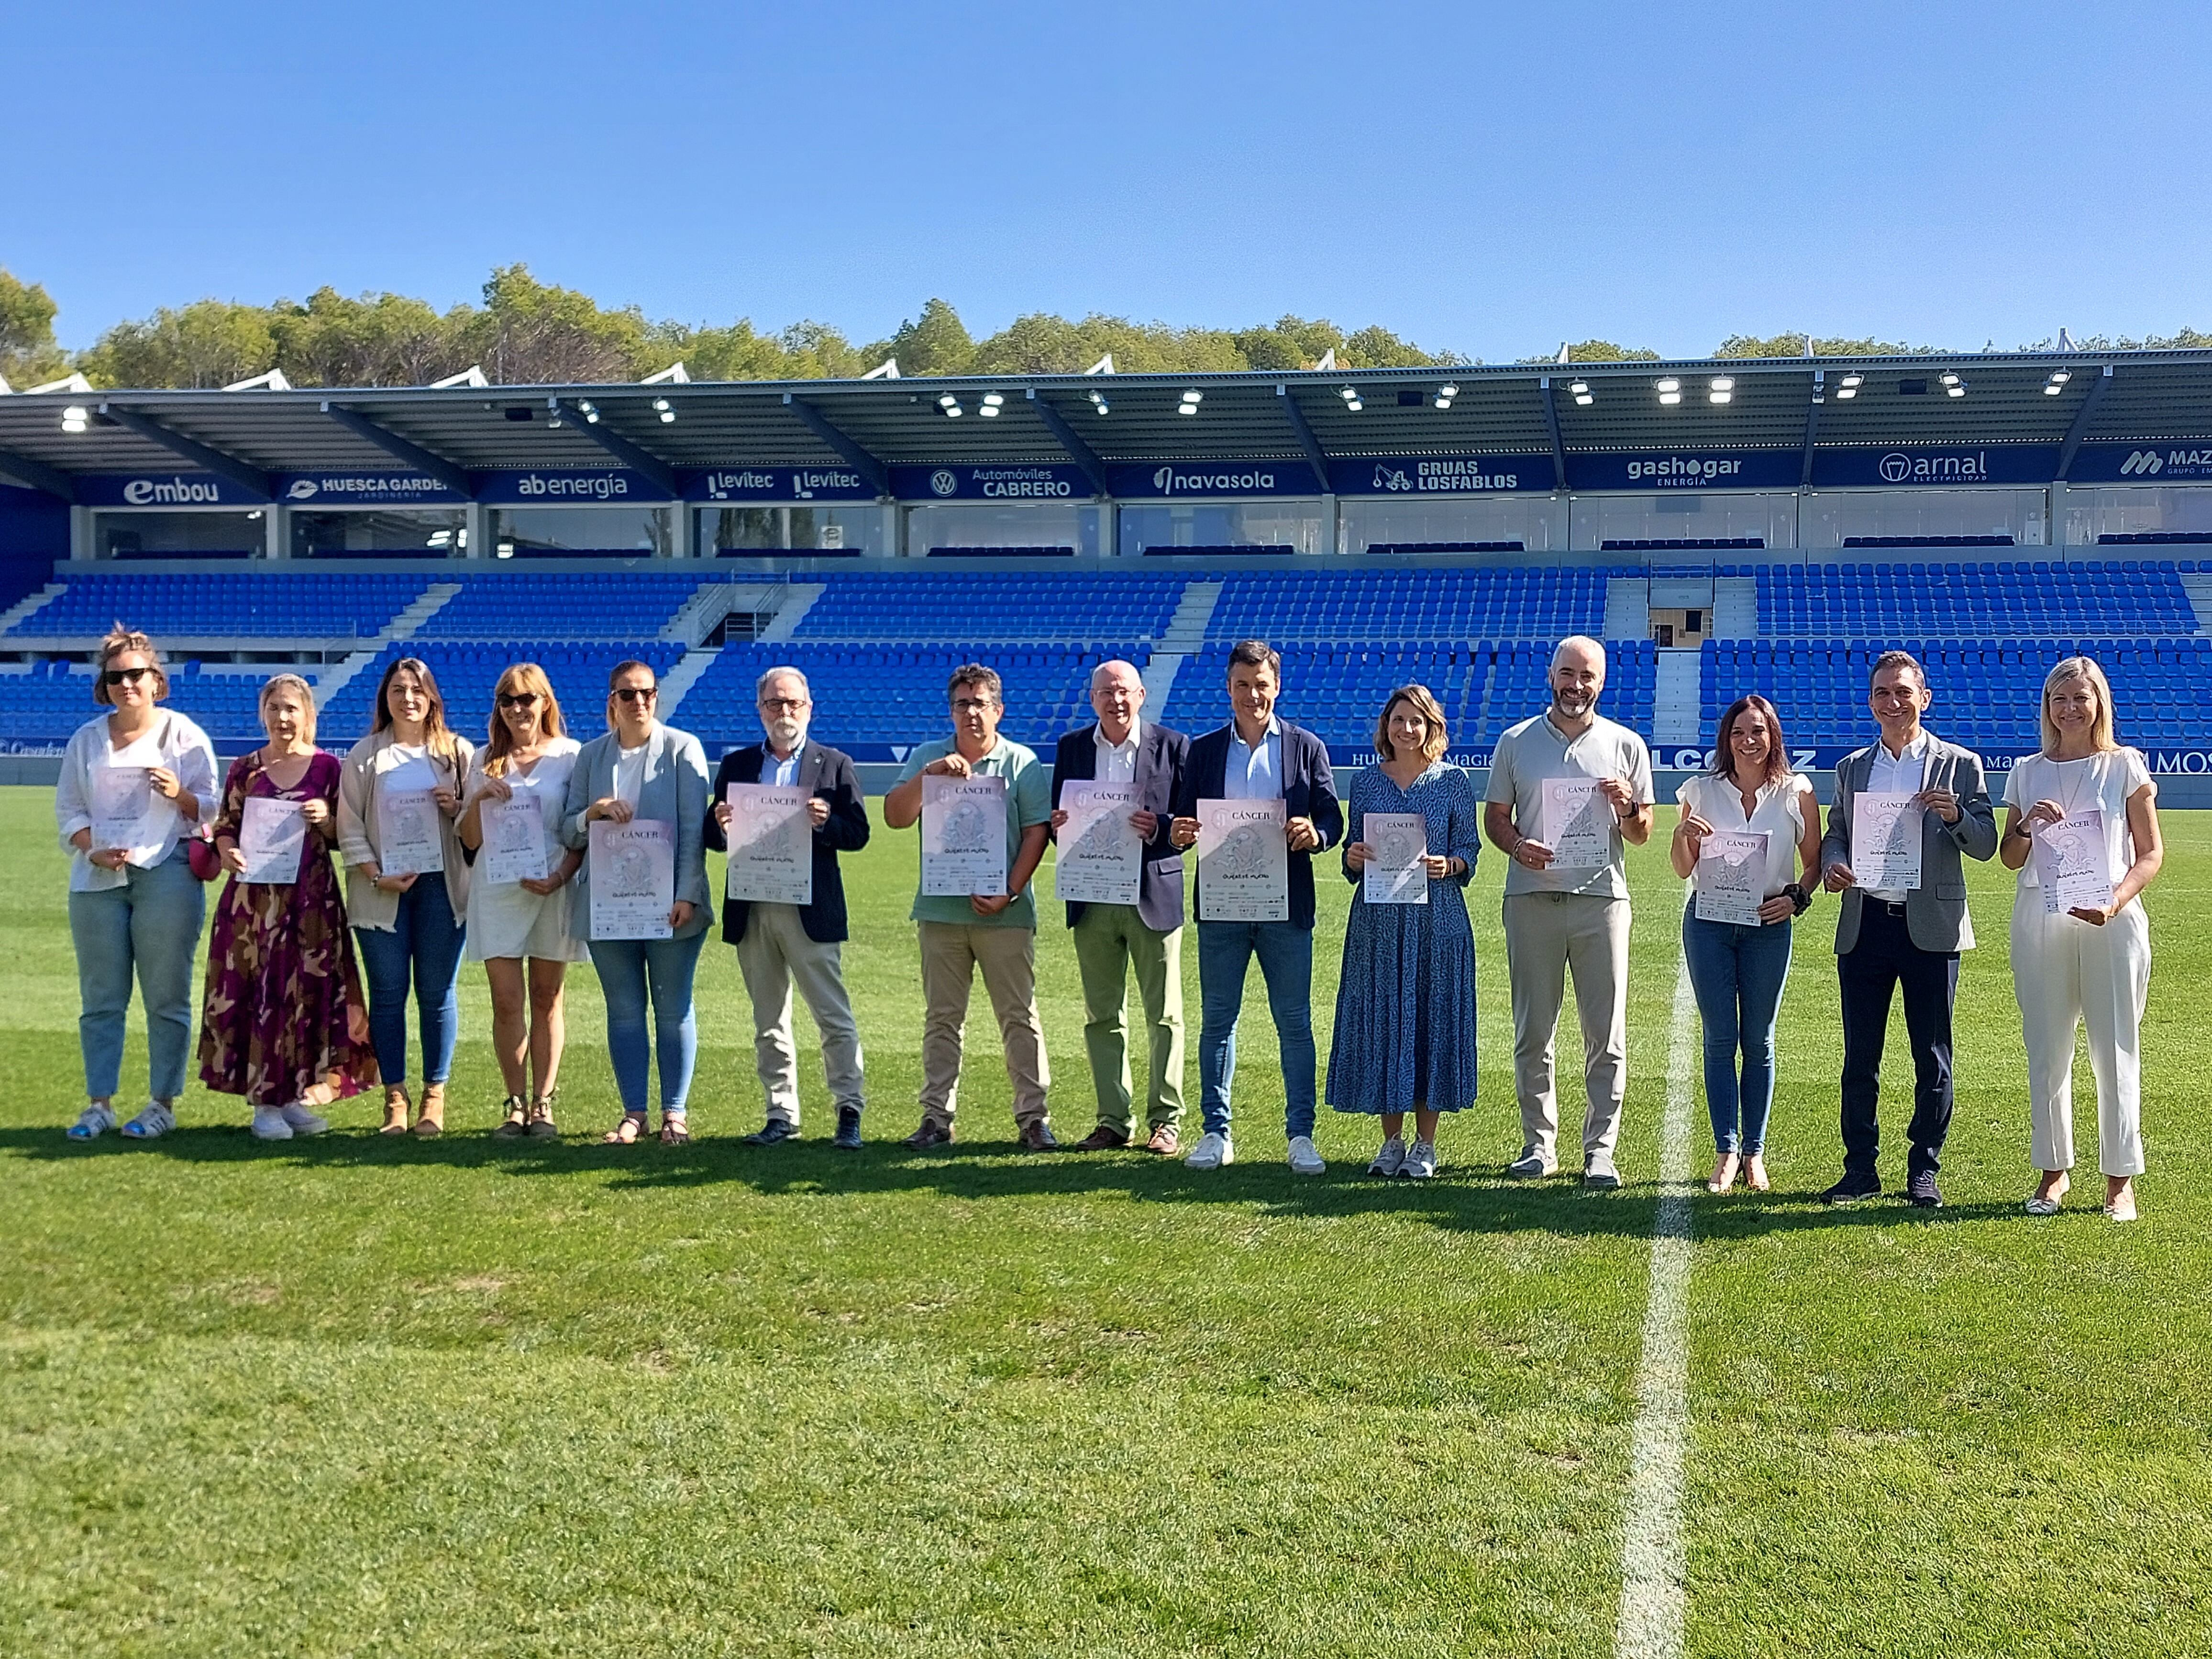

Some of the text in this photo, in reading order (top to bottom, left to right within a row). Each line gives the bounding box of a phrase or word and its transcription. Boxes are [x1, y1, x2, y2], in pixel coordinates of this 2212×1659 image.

[1418, 461, 1478, 476] GRUAS
[1914, 451, 1987, 475] arnal
[973, 469, 1052, 480] Automóviles
[1175, 471, 1274, 489] navasola
[390, 478, 447, 491] GARDE
[1418, 475, 1517, 490] LOSFABLOS
[123, 476, 219, 505] embou
[984, 481, 1071, 497] CABRERO
[955, 785, 991, 795] CÁNCER
[761, 794, 797, 806] CÁNCER
[1093, 791, 1129, 802] CÁNCER
[1232, 810, 1270, 819] CÁNCER
[2058, 820, 2090, 830] CÁNCER
[622, 830, 658, 839] CÁNCER
[1726, 840, 1756, 849] CÁNCER
